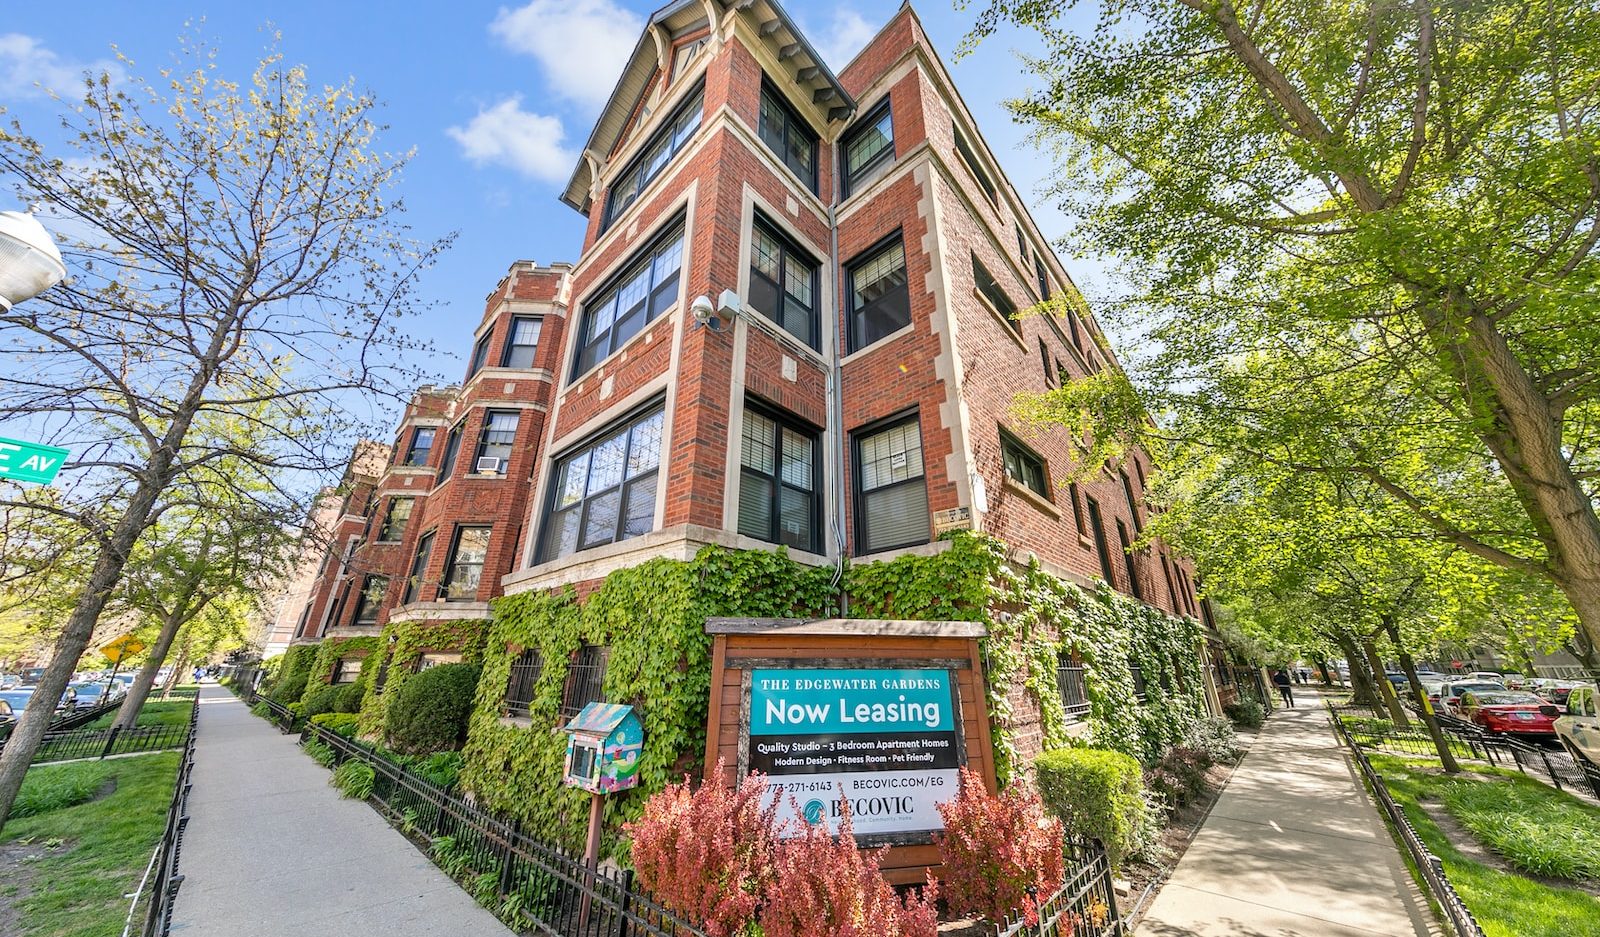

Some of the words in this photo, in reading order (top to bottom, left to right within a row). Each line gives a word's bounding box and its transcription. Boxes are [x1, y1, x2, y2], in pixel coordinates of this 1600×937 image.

[19, 455, 56, 471] AV
[761, 679, 790, 690] THE
[795, 679, 877, 690] EDGEWATER
[882, 679, 941, 689] GARDENS
[765, 698, 830, 724] Now
[839, 695, 940, 727] Leasing
[757, 743, 790, 754] Quality
[792, 742, 821, 752] Studio
[837, 742, 875, 750] Bedroom
[876, 740, 920, 750] Apartment
[922, 739, 949, 748] Homes
[775, 757, 804, 767] Modern
[806, 756, 832, 767] Design
[906, 753, 935, 763] Friendly
[853, 776, 944, 790] BECOVIC.COM/EG
